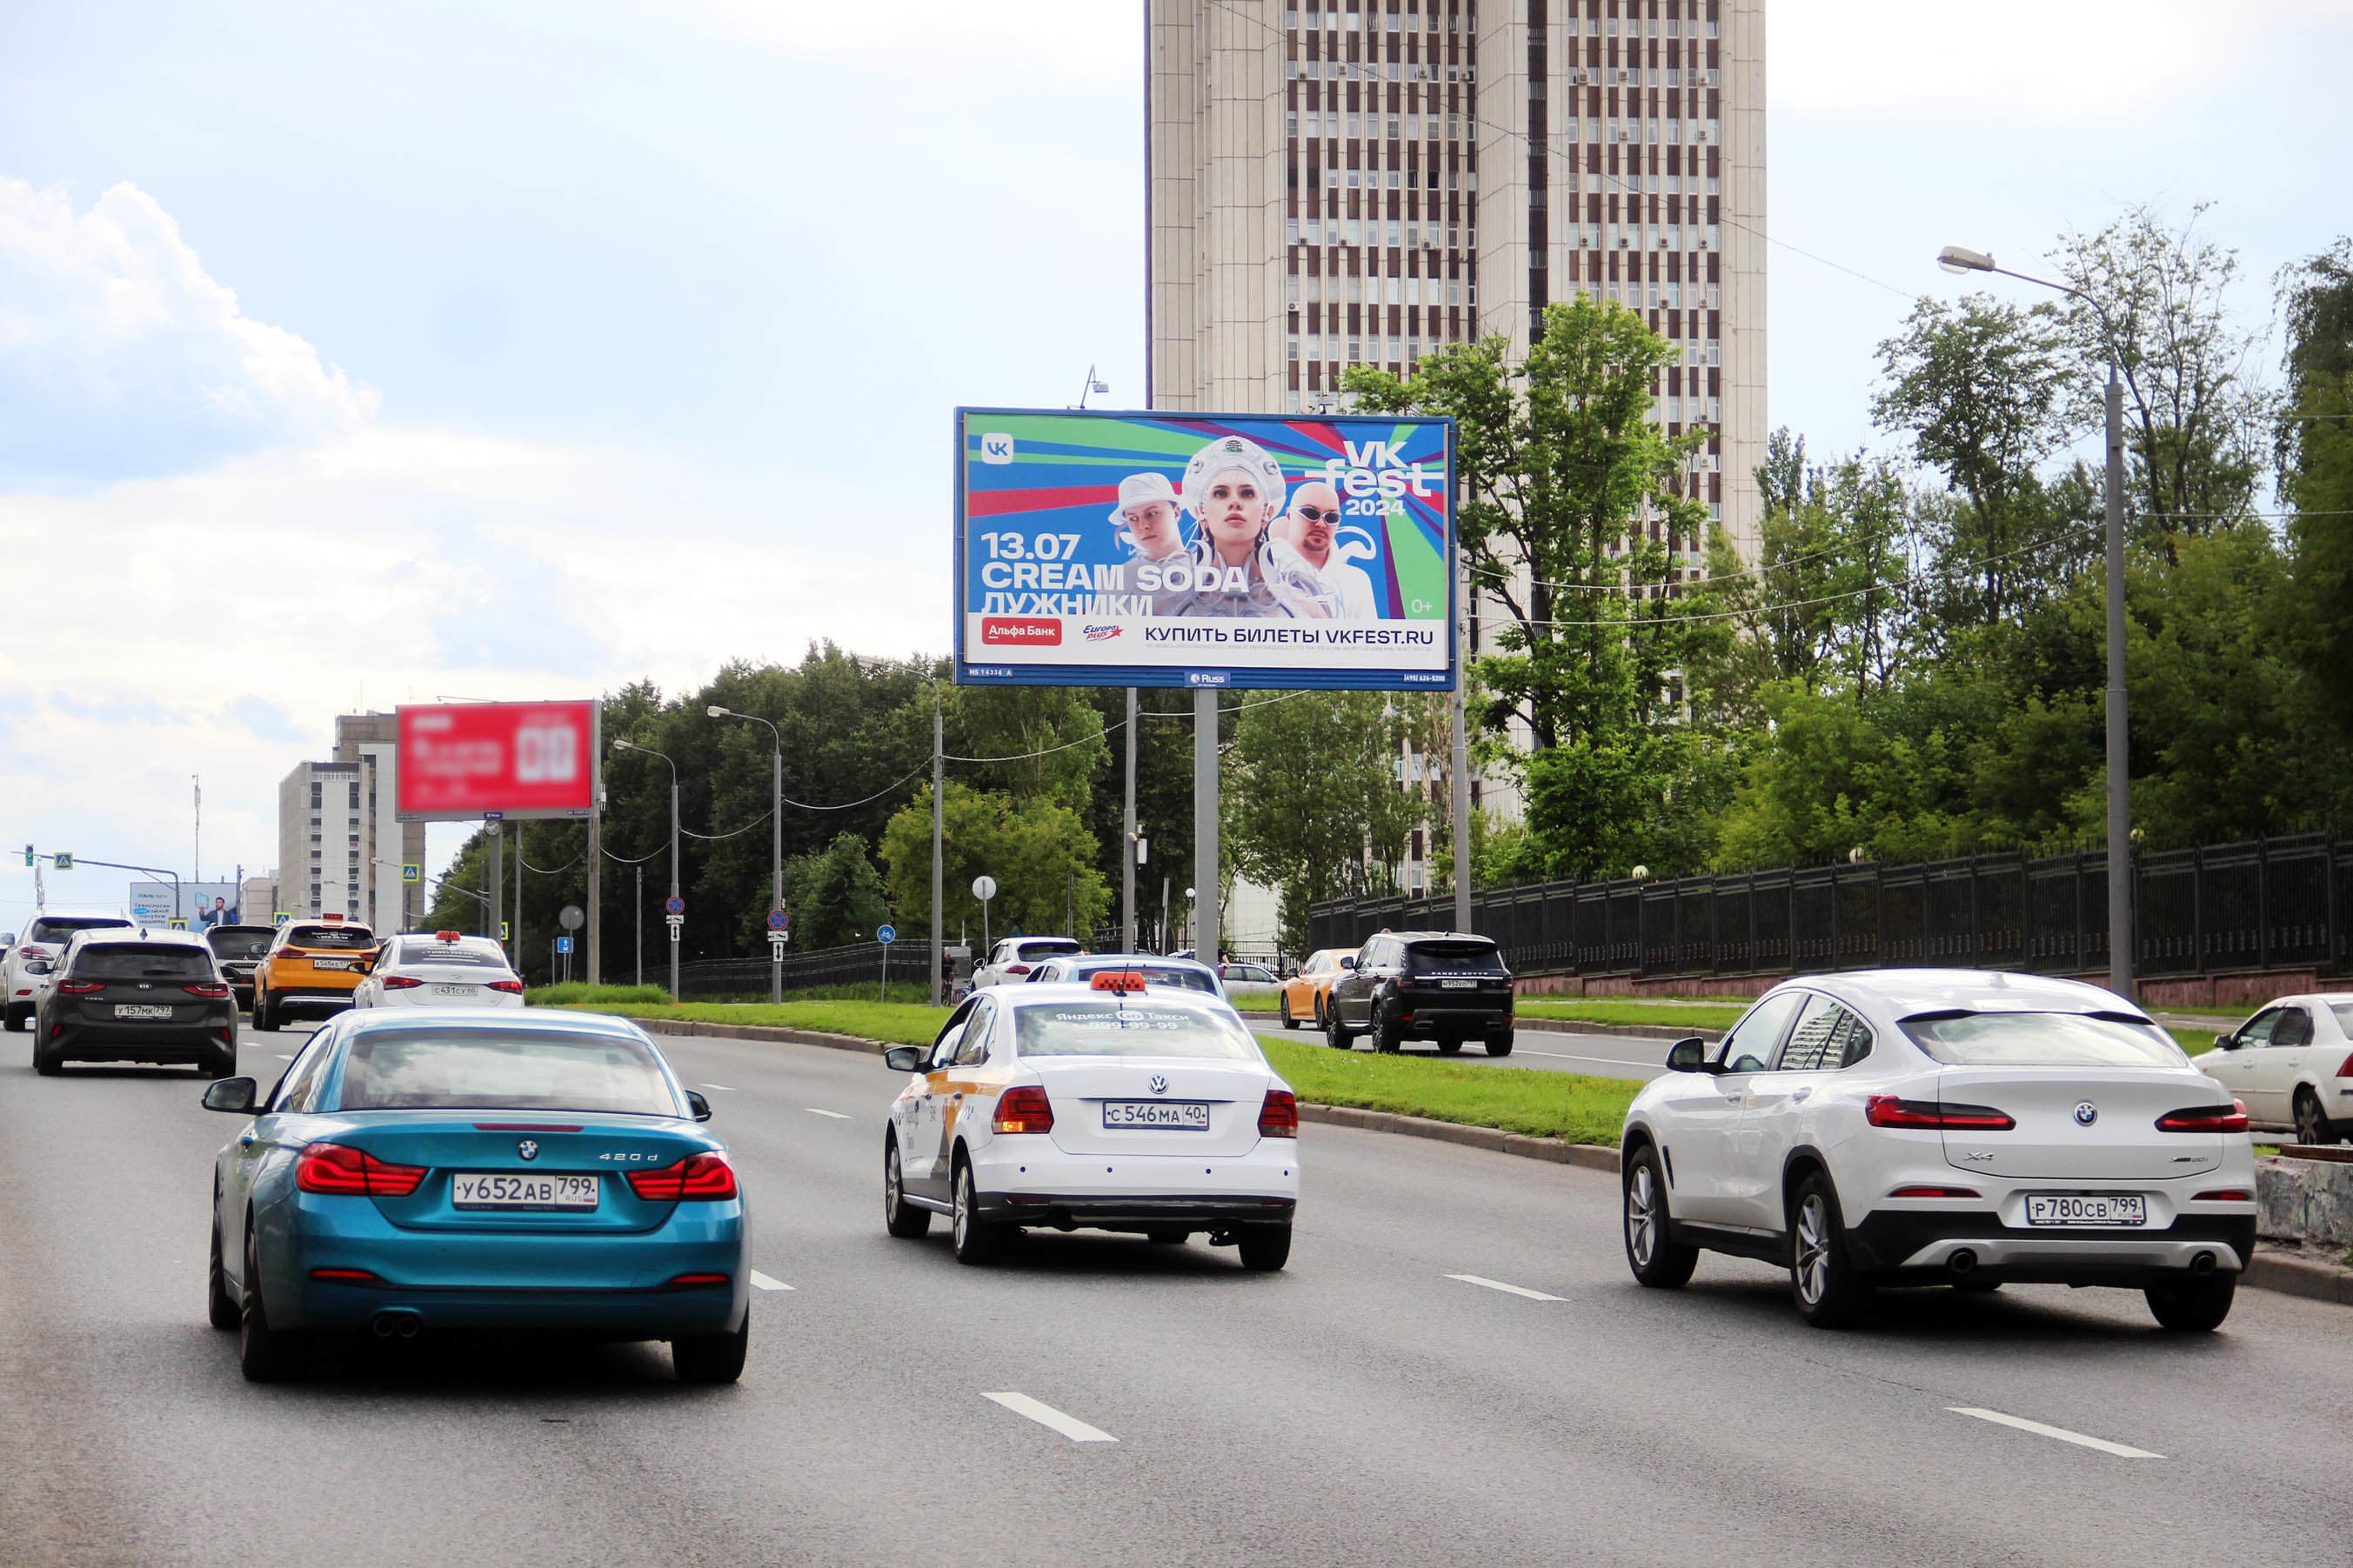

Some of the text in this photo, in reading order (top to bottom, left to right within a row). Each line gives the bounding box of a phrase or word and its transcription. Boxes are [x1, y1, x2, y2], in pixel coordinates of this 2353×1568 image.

[987, 442, 1008, 457] VK
[1343, 440, 1407, 468] VK
[1305, 458, 1444, 497] fest
[1346, 498, 1406, 517] 2024
[981, 531, 1080, 561] 13.07
[981, 561, 1250, 593] CREAM SODA
[981, 591, 1153, 616] ЛУЖНИКИ
[1411, 598, 1434, 613] 0+
[988, 624, 1056, 637] Альфа Банк
[1145, 627, 1434, 644] КУПИТЬ БИЛЕТЫ VKFEST.RU
[1201, 673, 1225, 684] Russ
[1056, 1012, 1114, 1022] Яндекс
[1145, 1011, 1190, 1022] Такси
[1185, 1106, 1201, 1119] 40
[462, 1177, 592, 1201] У652АВ 799
[2035, 1198, 2138, 1218] Р780СВ 799
